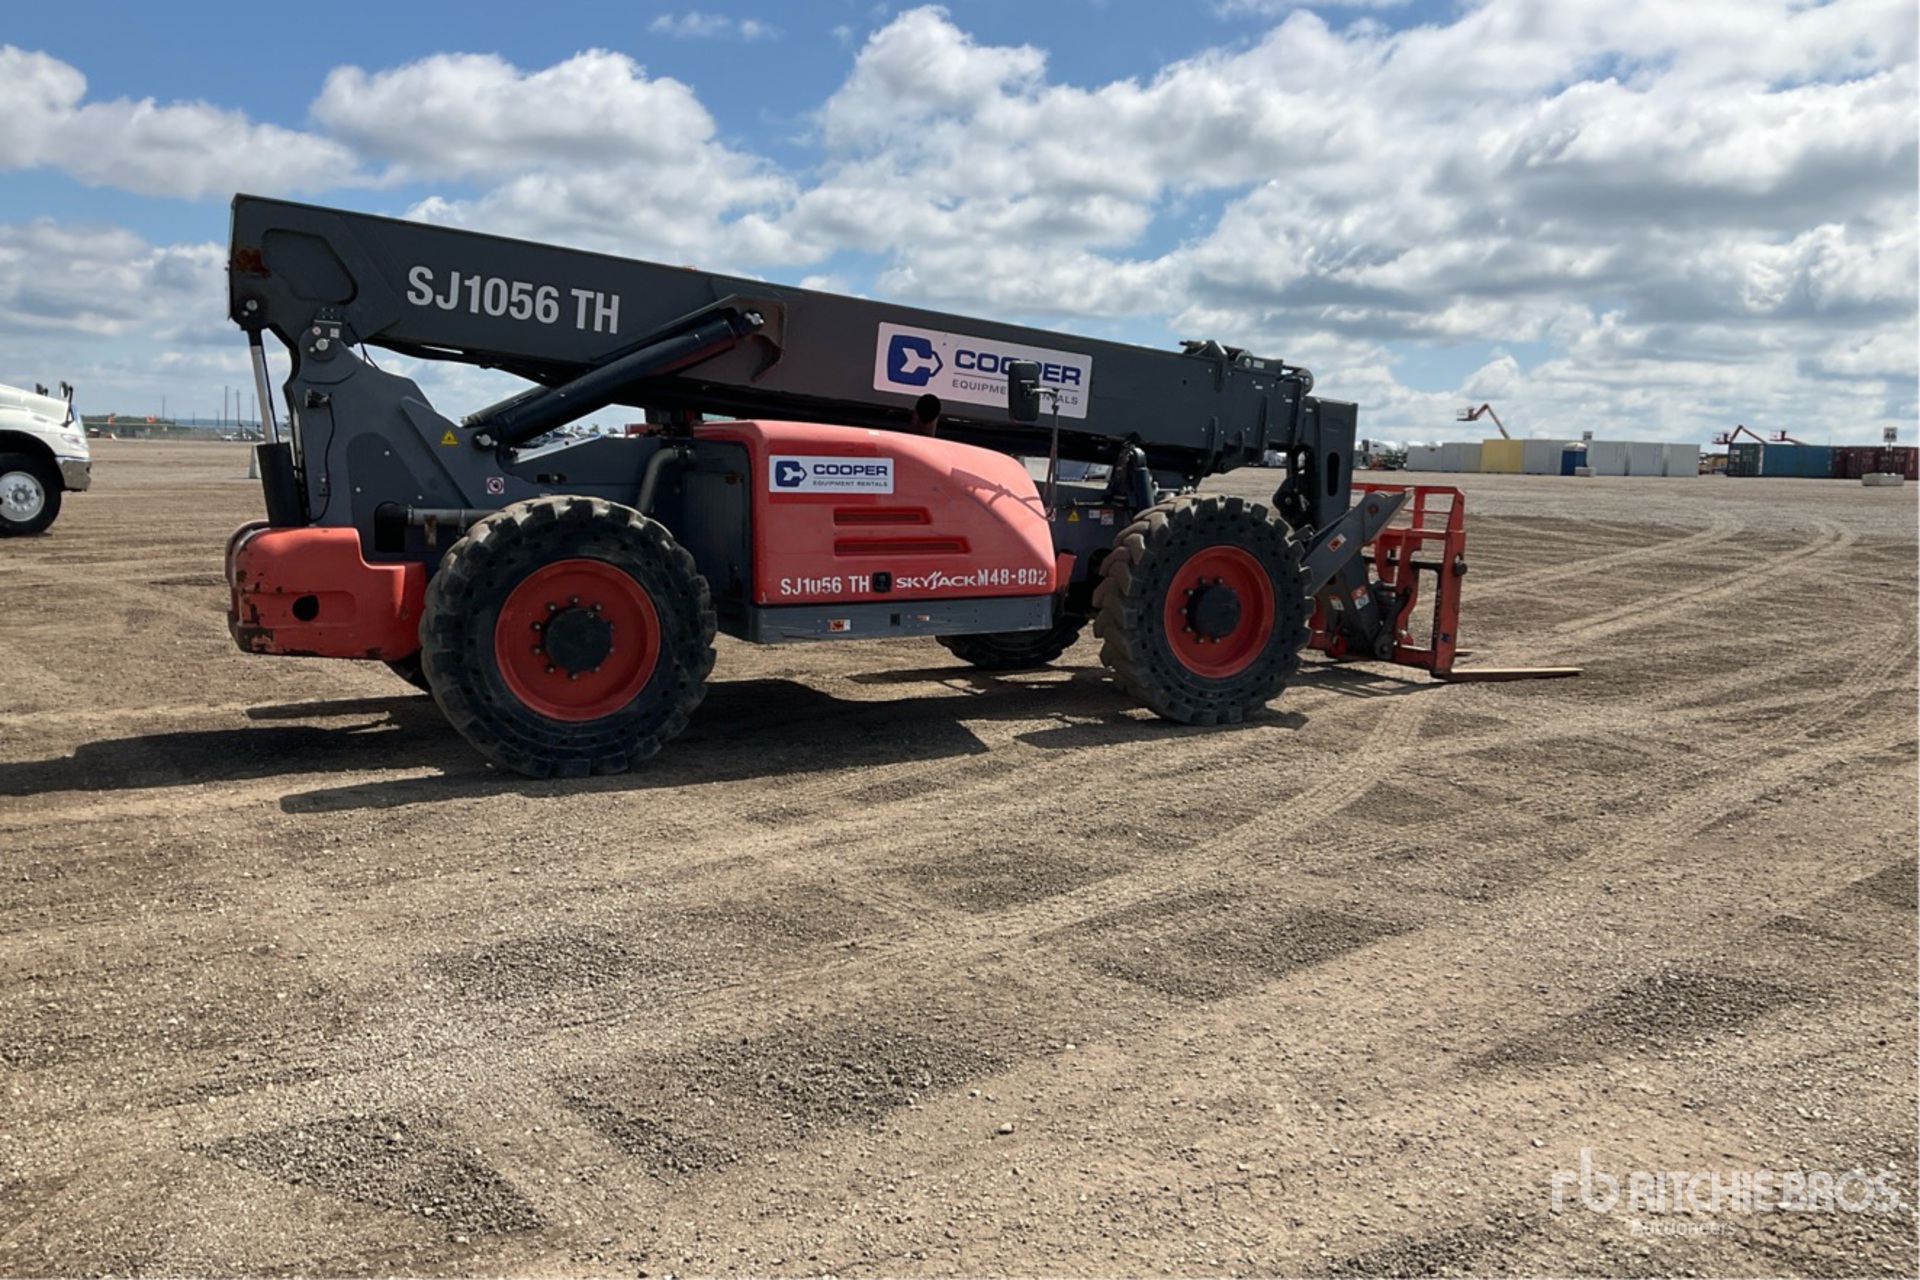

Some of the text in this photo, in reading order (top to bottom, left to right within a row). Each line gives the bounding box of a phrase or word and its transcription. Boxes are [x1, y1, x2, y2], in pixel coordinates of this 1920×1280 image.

[407, 266, 620, 334] SJ1056 TH
[955, 349, 1081, 386] COOER
[952, 379, 1007, 395] EQUIPME
[813, 464, 888, 476] COOPER
[848, 575, 870, 593] TH
[896, 571, 976, 590] SKYJACK
[977, 568, 1047, 586] M48-802
